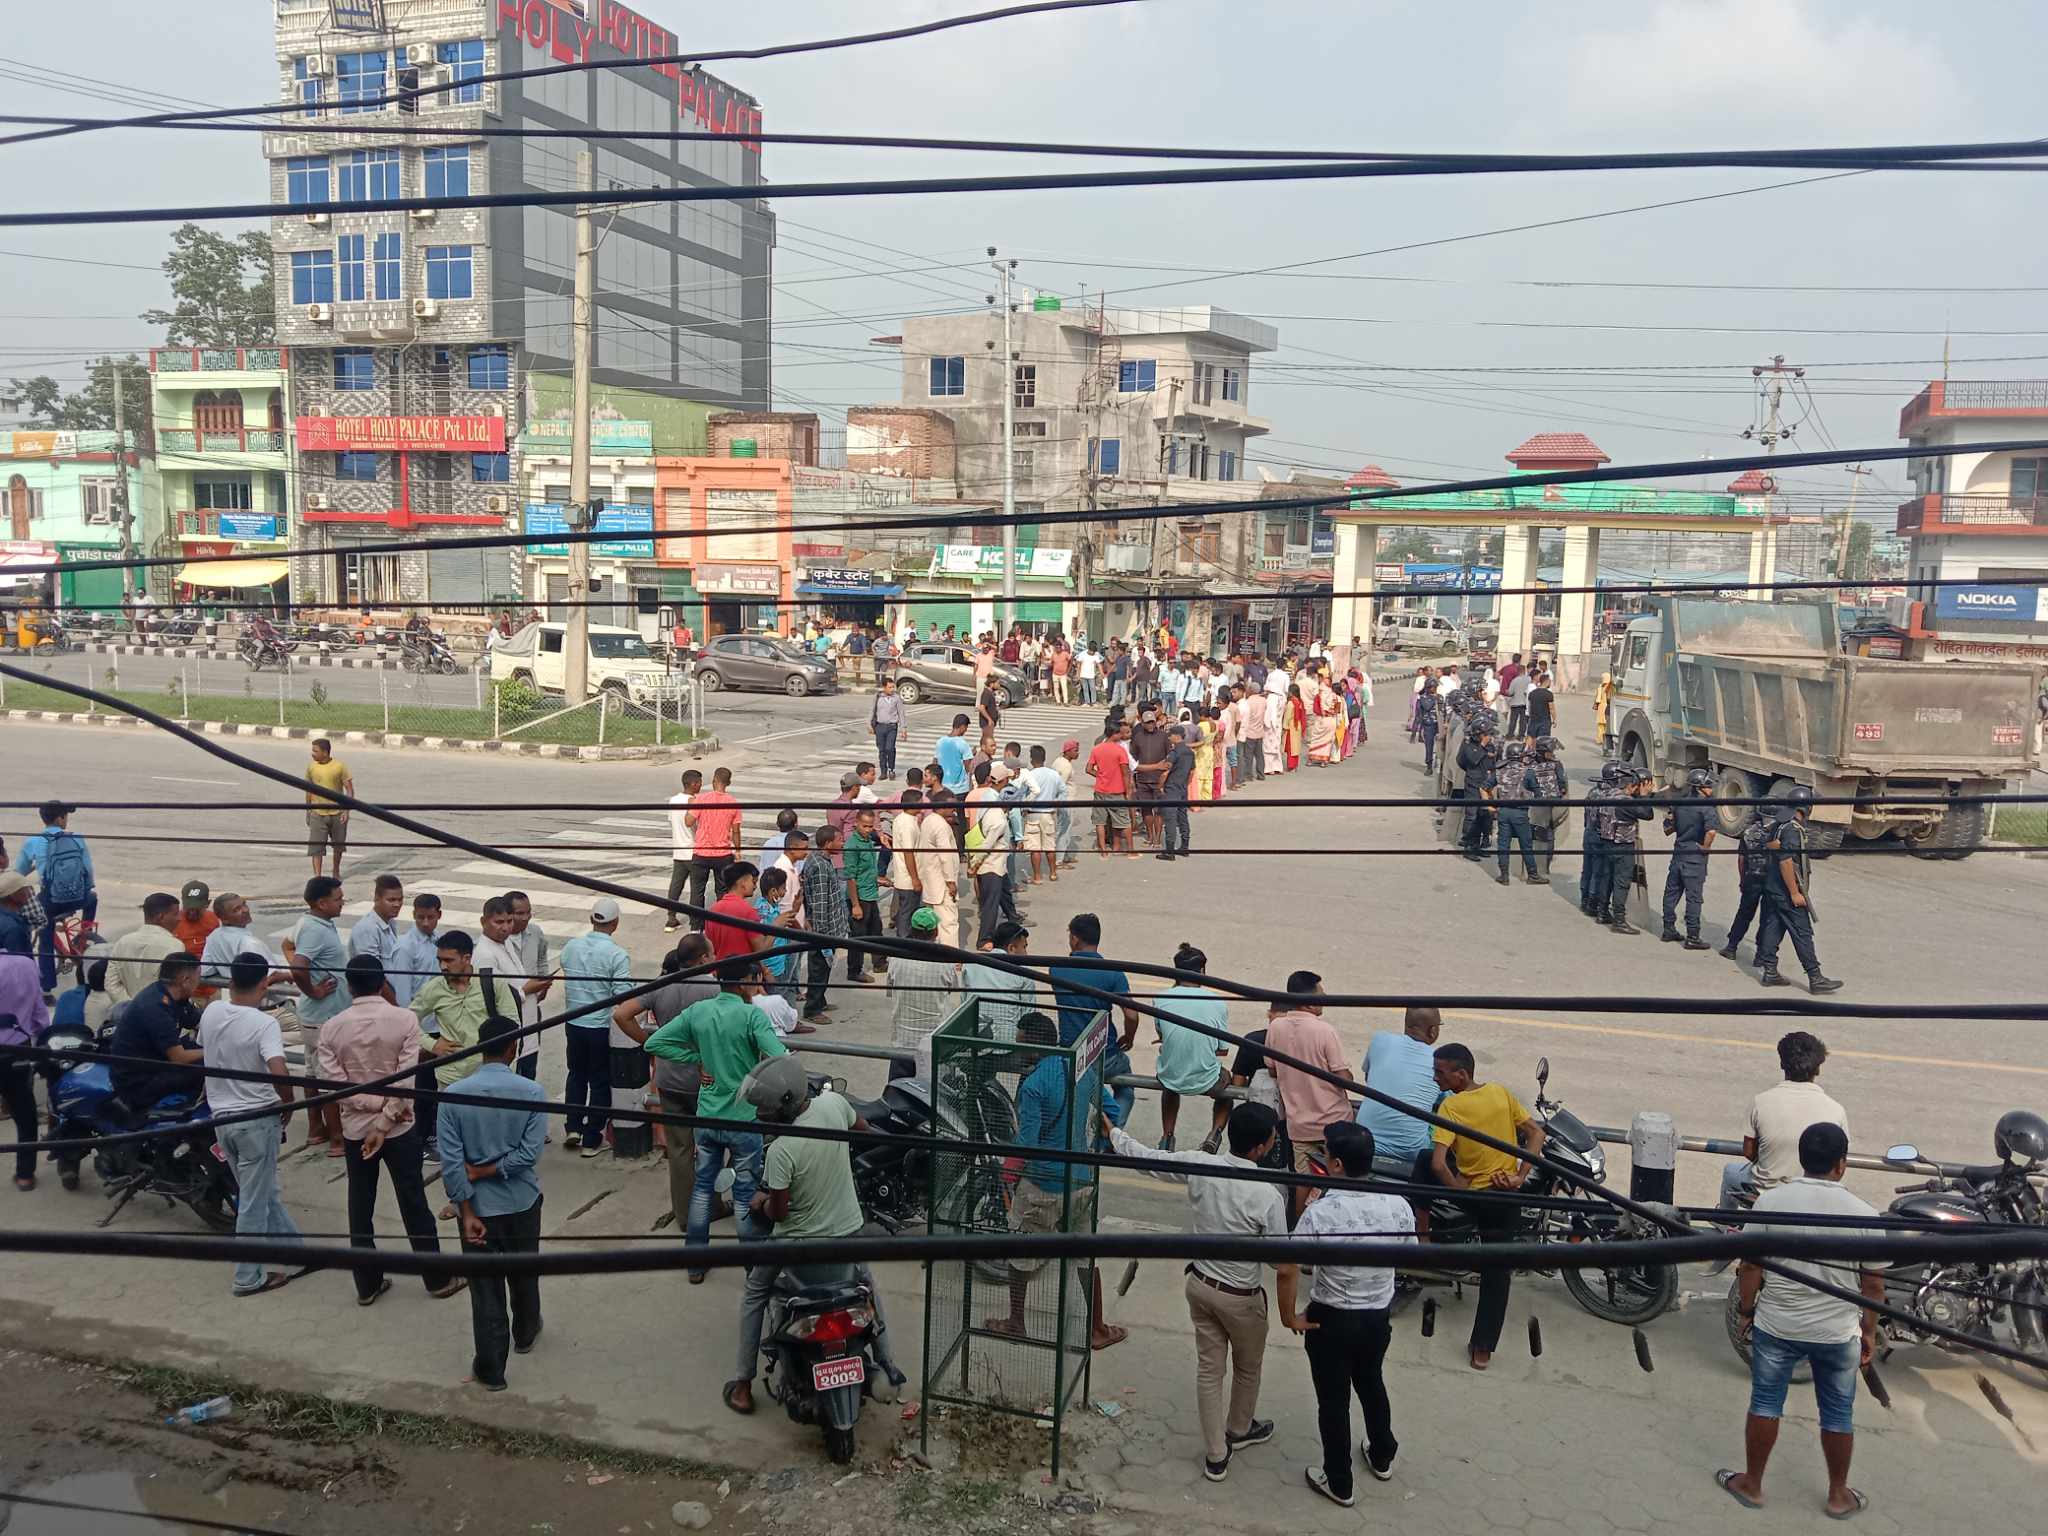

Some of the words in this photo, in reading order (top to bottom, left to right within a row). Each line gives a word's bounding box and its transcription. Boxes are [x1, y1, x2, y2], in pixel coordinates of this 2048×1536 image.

[679, 73, 762, 154] PALACE
[336, 418, 368, 441] HOTEL
[370, 418, 395, 441] HOLY
[400, 418, 440, 441] PALACE
[444, 419, 465, 442] Pvt.
[467, 420, 490, 442] Ltd.
[1957, 593, 2017, 605] NOKIA
